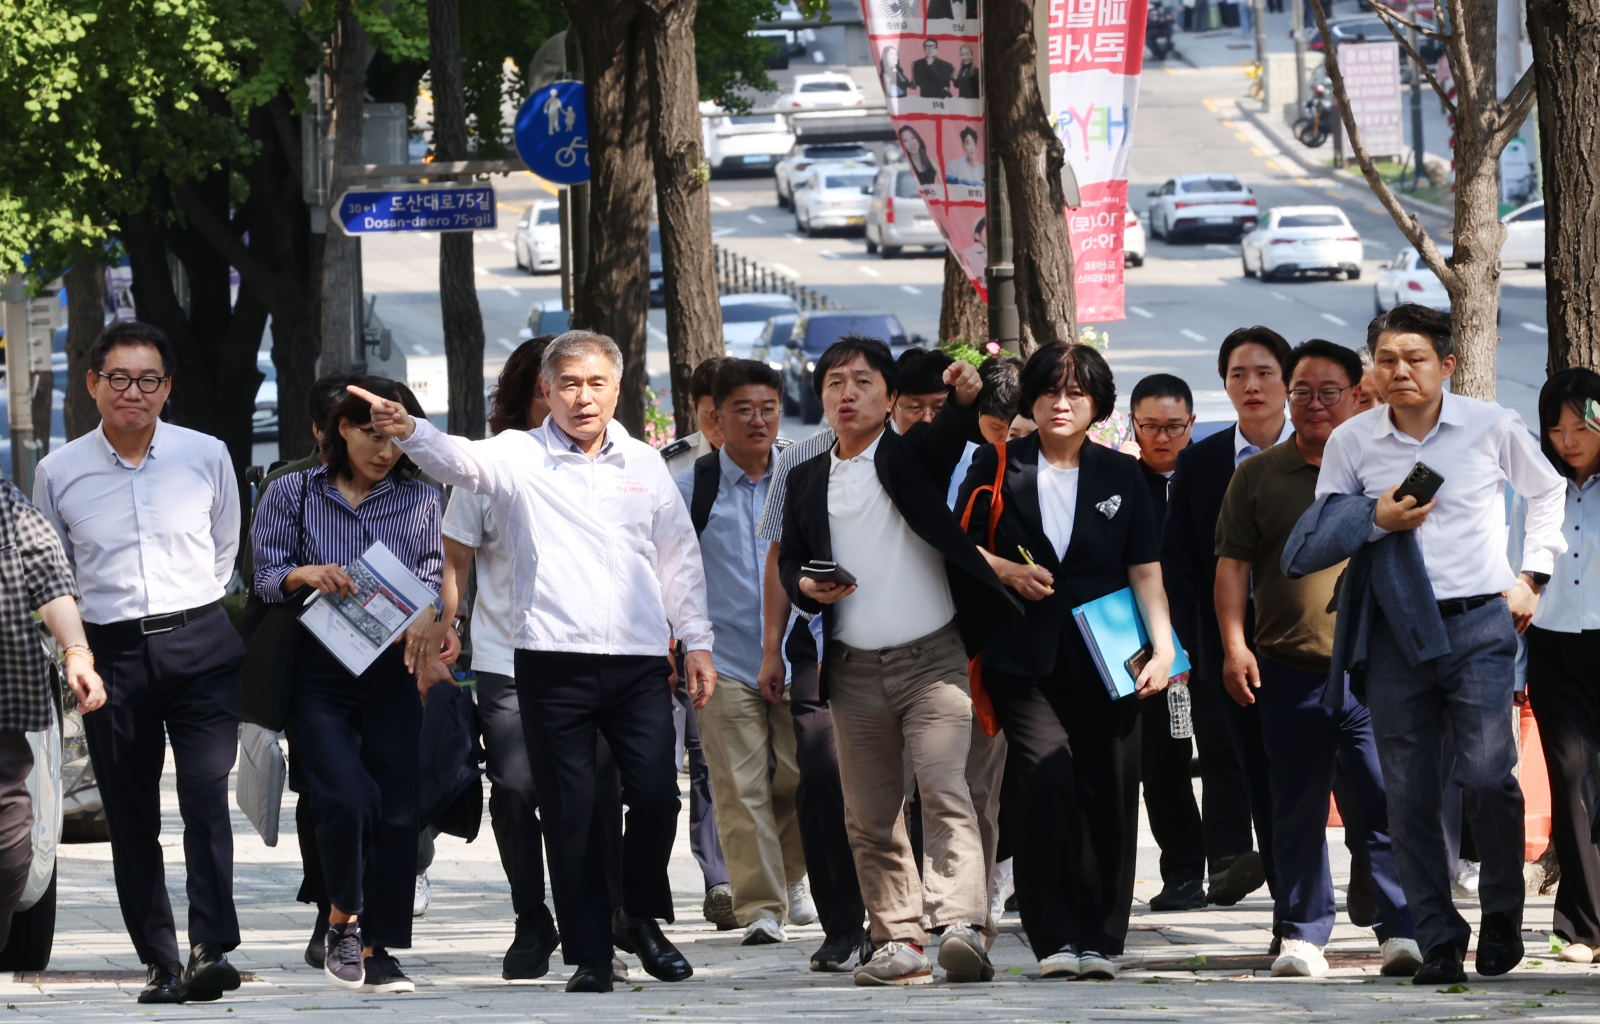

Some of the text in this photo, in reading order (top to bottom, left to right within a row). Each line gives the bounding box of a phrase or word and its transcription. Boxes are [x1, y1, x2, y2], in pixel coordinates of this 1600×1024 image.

[389, 191, 490, 213] 도산대로75길
[364, 213, 491, 230] Dosan-daero 75-gil
